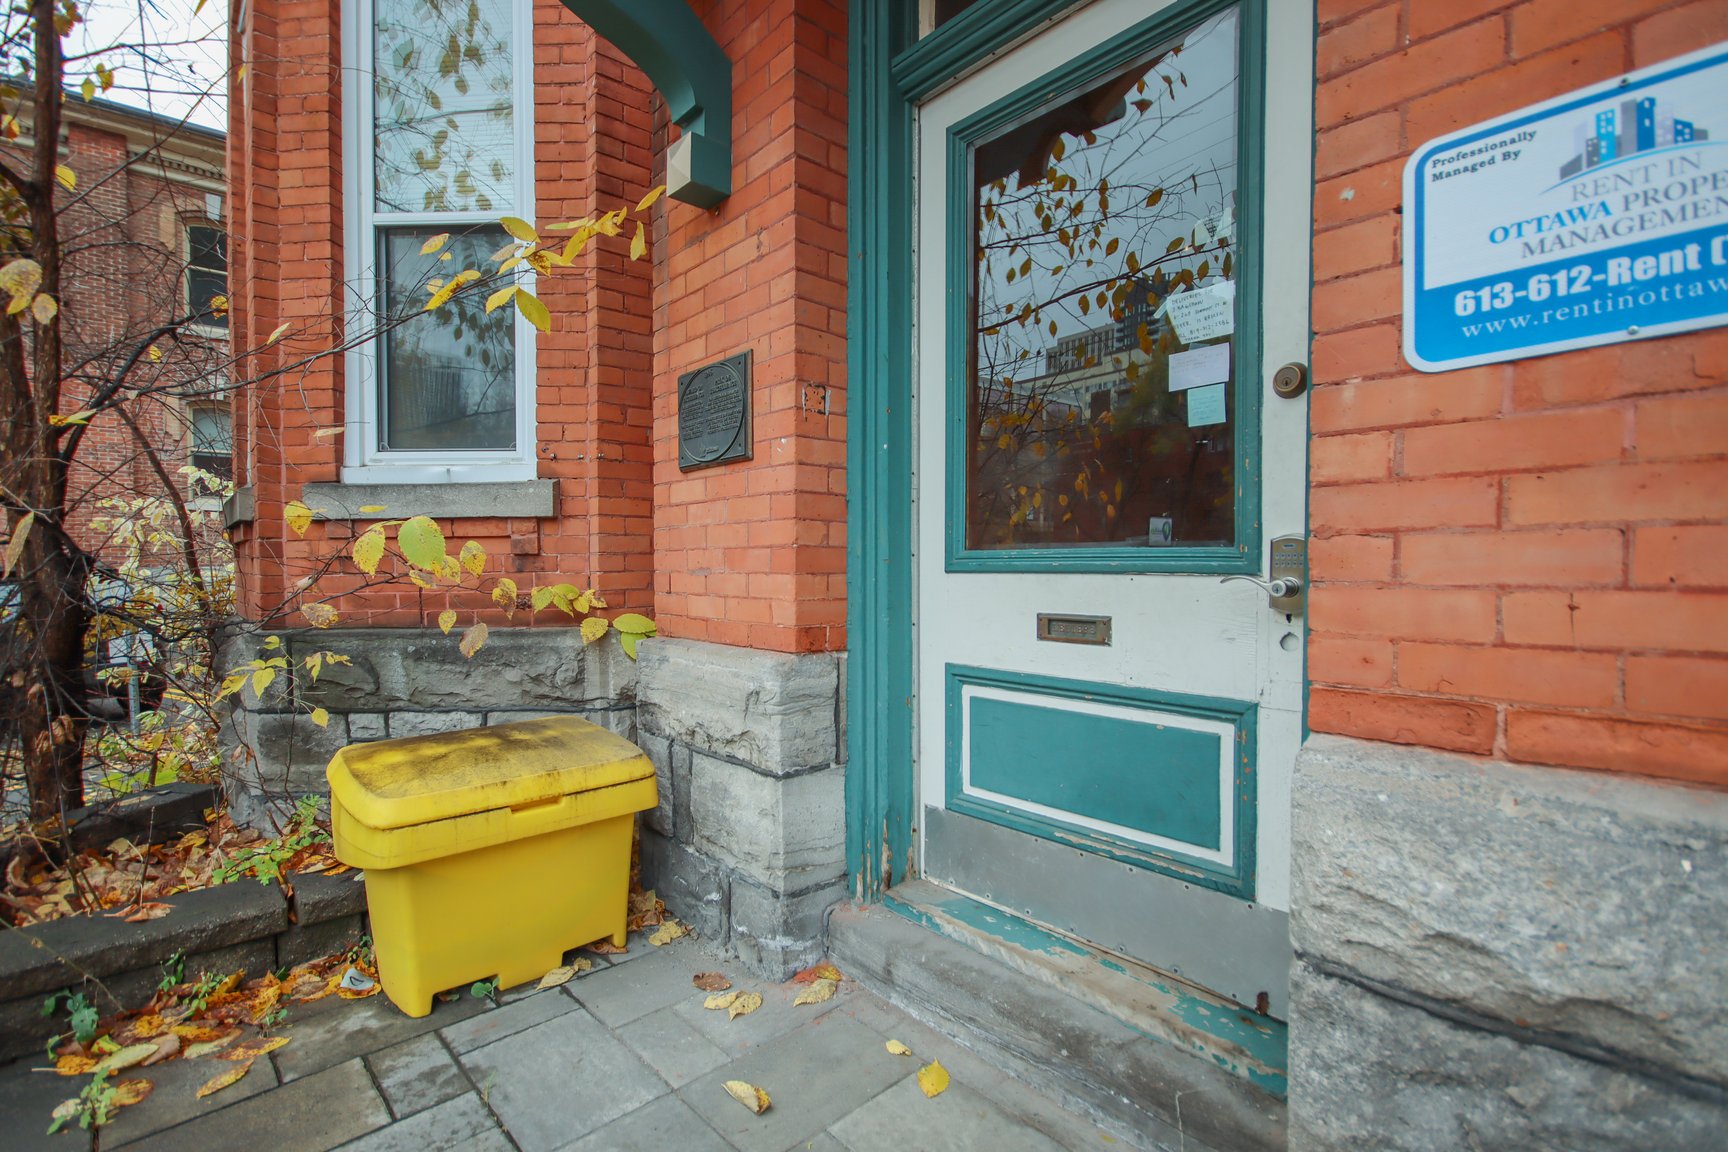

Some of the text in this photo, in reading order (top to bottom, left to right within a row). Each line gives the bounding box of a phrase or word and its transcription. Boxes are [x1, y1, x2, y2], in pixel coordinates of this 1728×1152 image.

[1432, 130, 1537, 168] Professionally
[1432, 149, 1522, 182] Managed By
[1571, 151, 1703, 202] RENT IN
[1489, 200, 1613, 245] OTTAWA
[1454, 243, 1702, 317] 613-612-Rent
